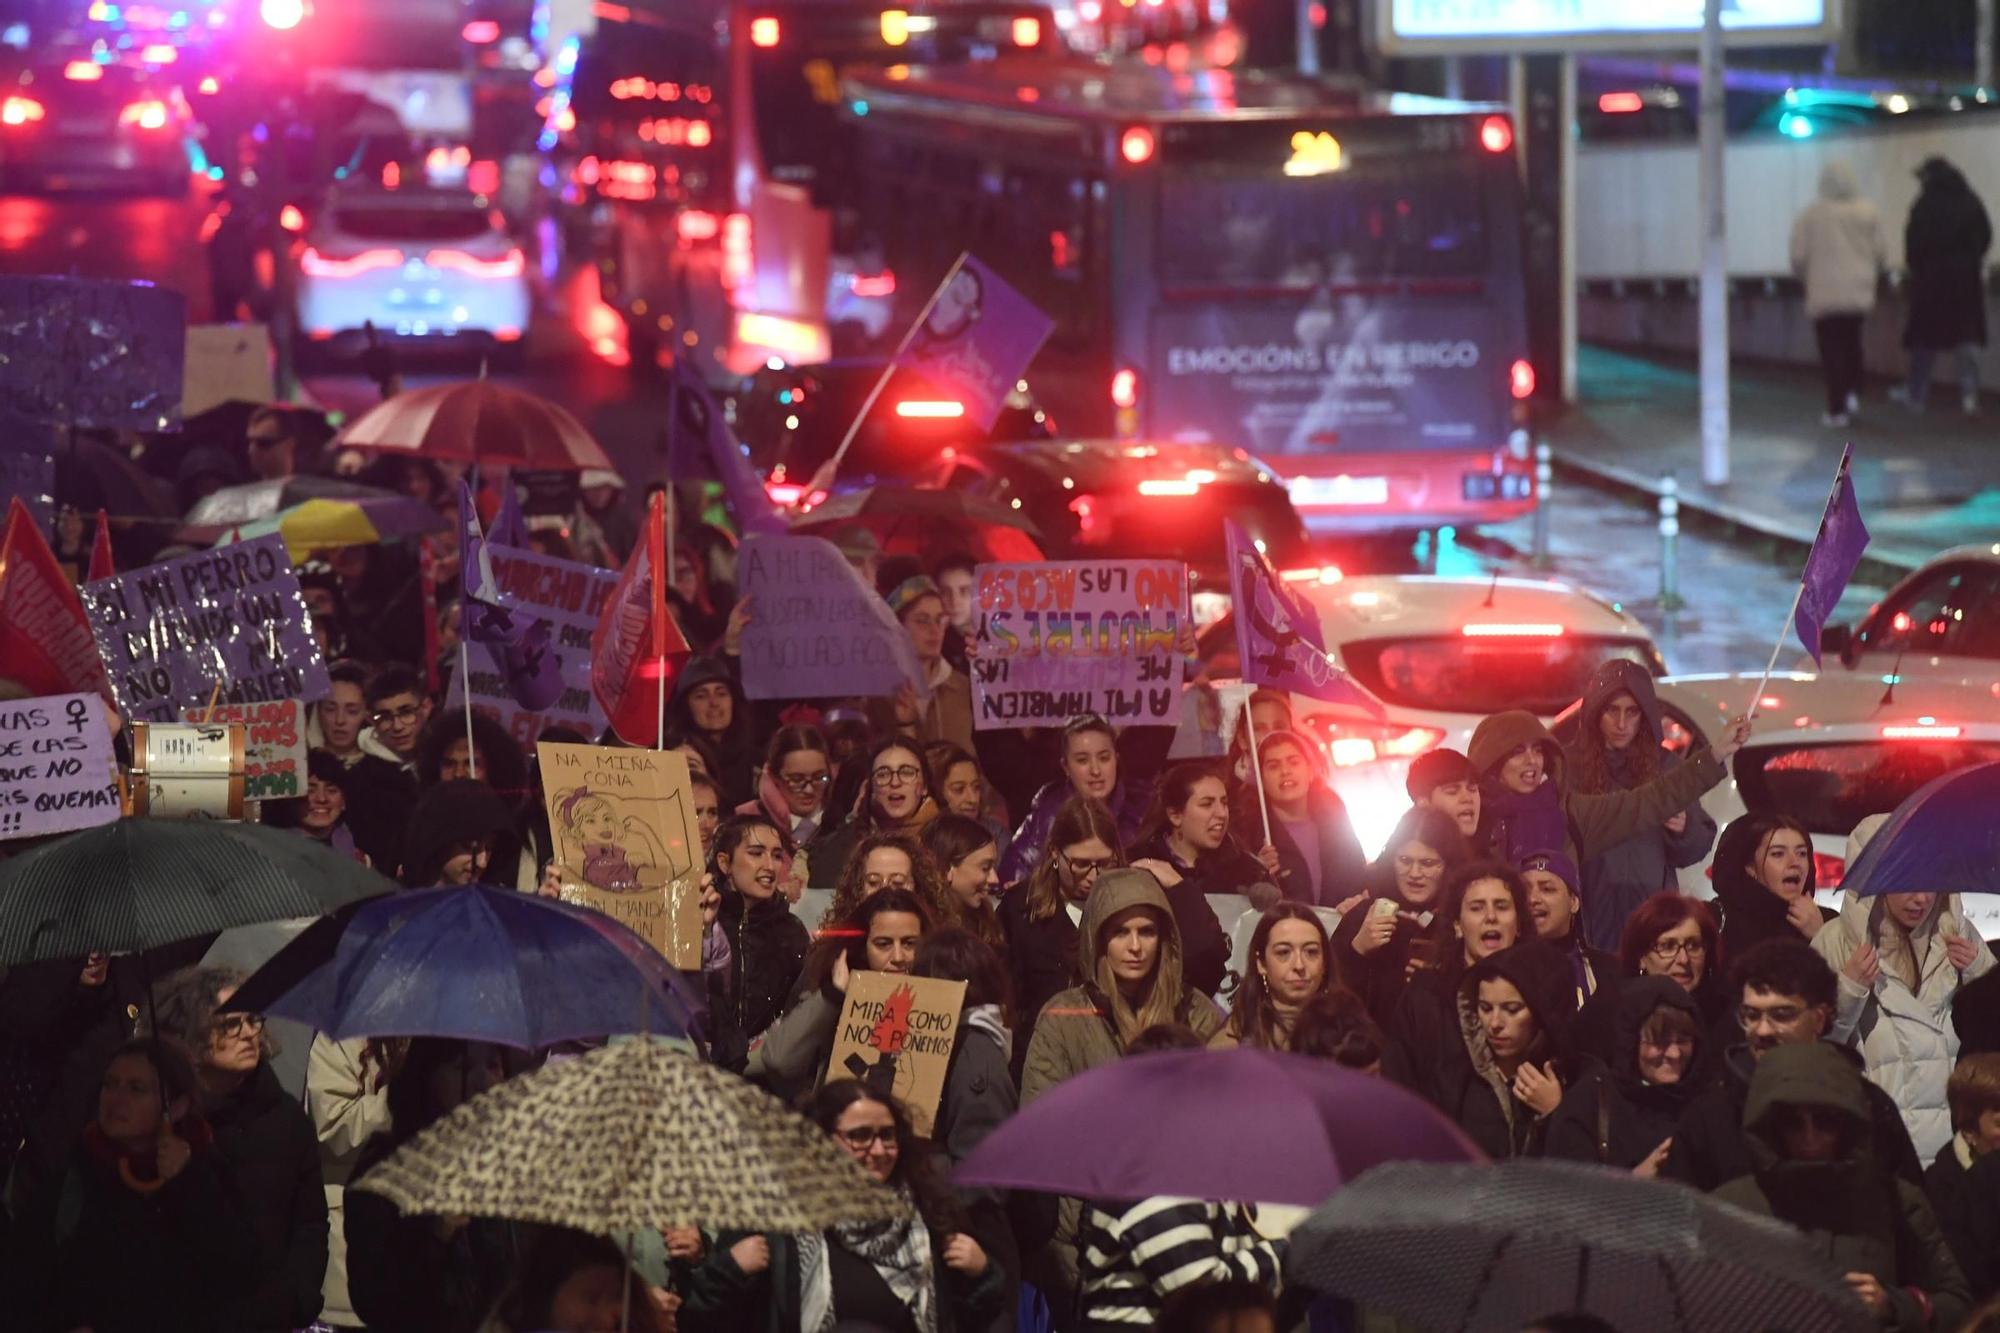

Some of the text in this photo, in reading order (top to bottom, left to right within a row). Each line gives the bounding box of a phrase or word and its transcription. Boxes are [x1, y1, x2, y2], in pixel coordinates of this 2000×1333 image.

[138, 571, 177, 611] MI
[181, 547, 276, 598] PERRO
[978, 567, 1181, 611] NO LAS ACOSO
[242, 591, 283, 627] UN
[976, 611, 1178, 658] MUJERES Y
[125, 666, 171, 702] NO
[974, 655, 1172, 690] ME GUSTAN LAS
[1150, 688, 1172, 717] A
[1, 709, 50, 731] LAS
[33, 737, 88, 754] LAS
[45, 757, 82, 778] NO
[556, 752, 658, 773] NA MIÑA
[584, 771, 634, 787] CONA
[35, 783, 119, 812] QUEMAR
[850, 999, 951, 1032] MIRA COMO
[844, 1024, 881, 1048] NOS
